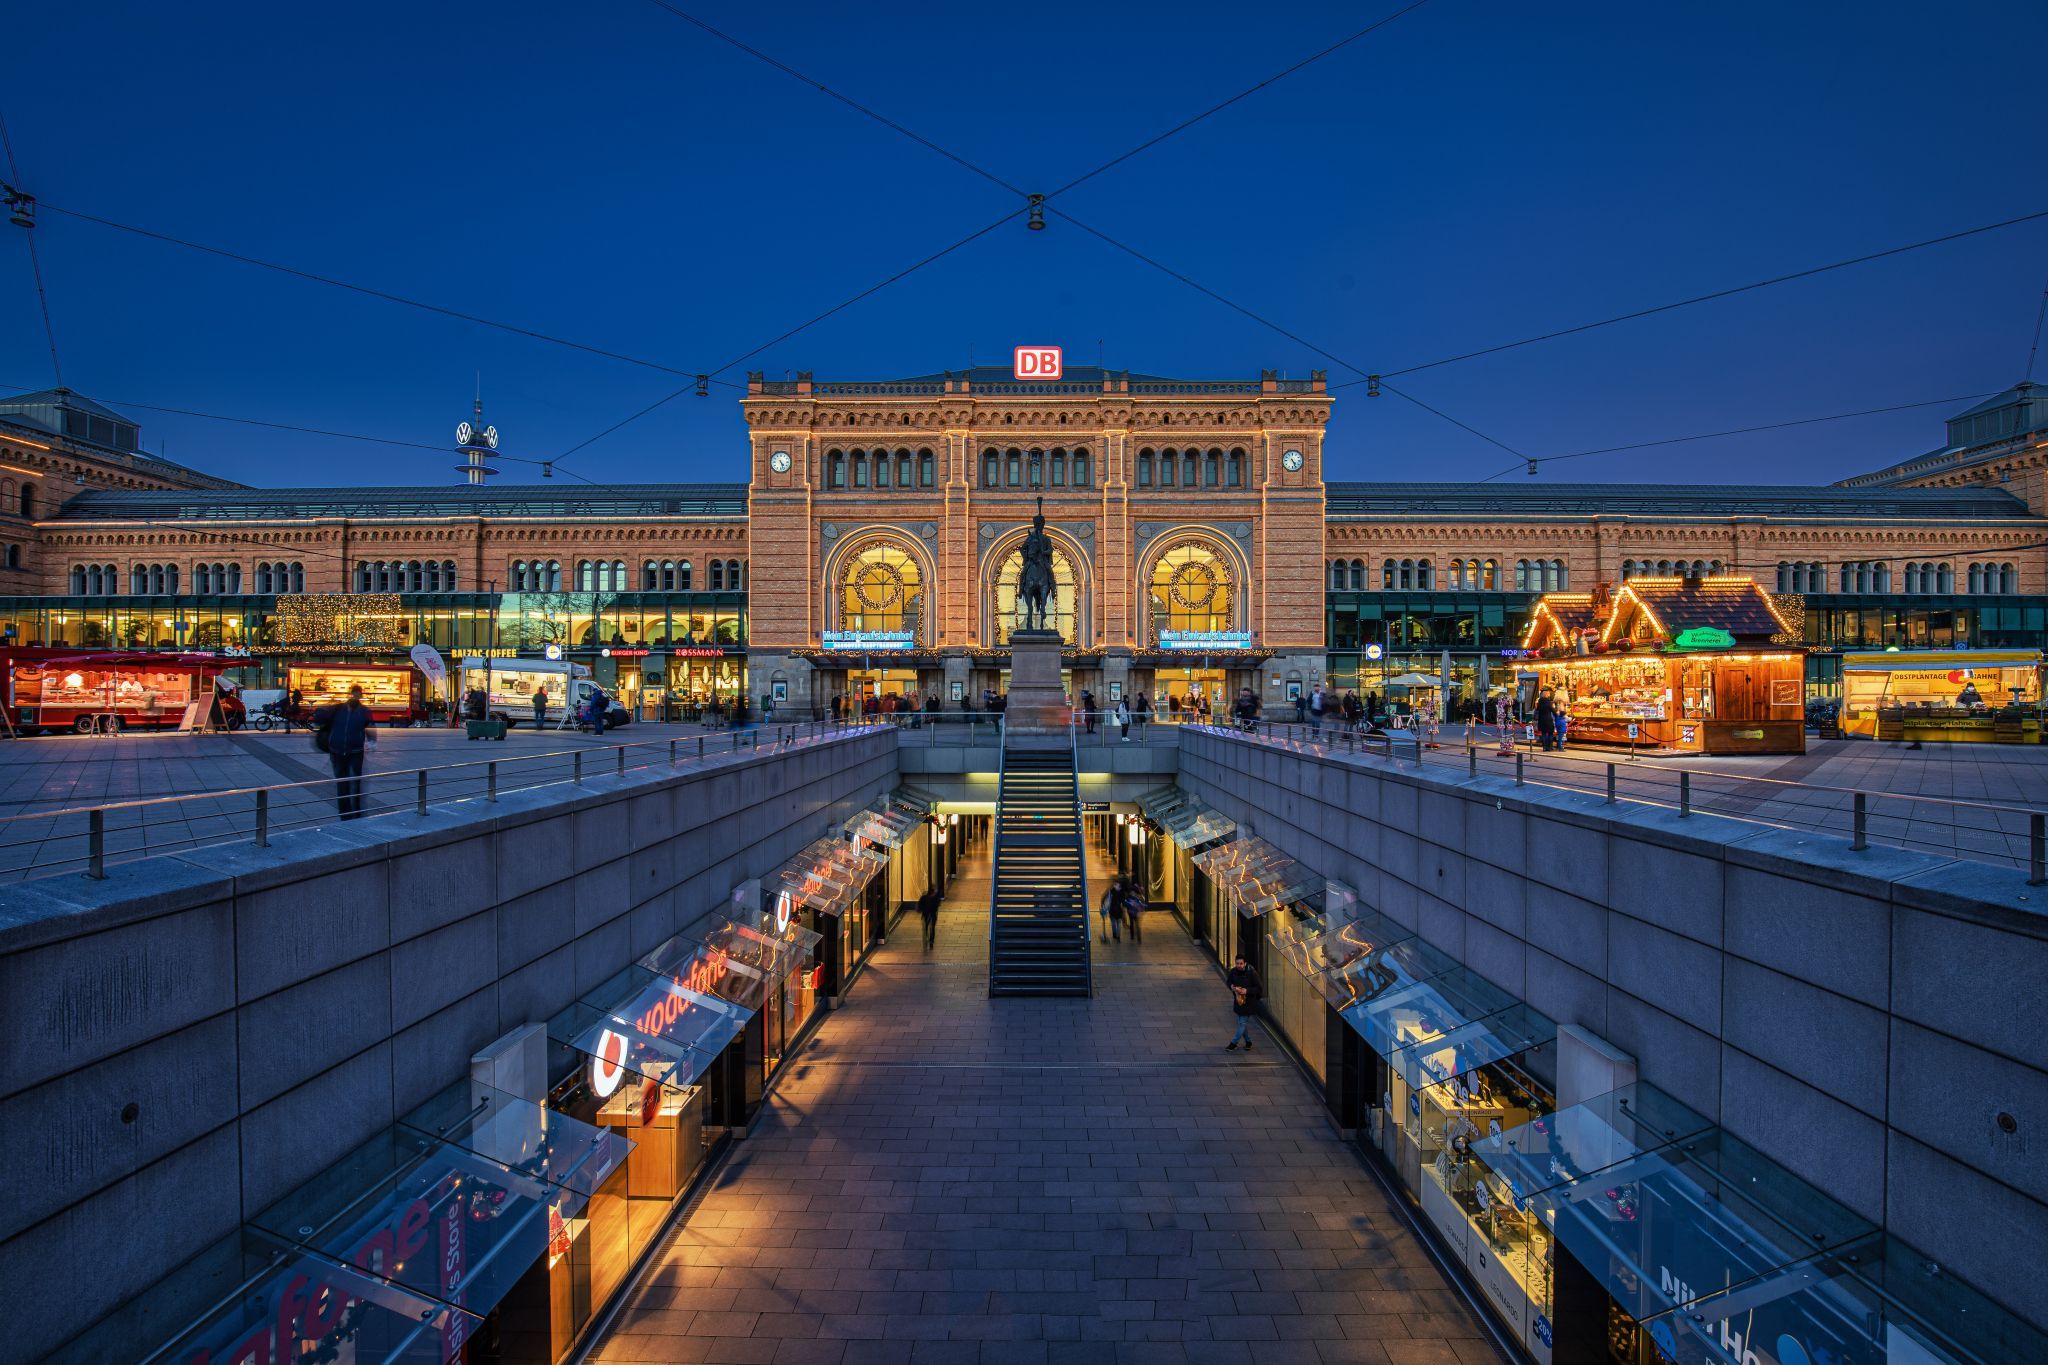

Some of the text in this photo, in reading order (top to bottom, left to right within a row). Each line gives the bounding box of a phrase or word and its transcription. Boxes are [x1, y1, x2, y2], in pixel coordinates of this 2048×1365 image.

[1020, 352, 1057, 374] DB
[456, 422, 472, 445] VW
[823, 630, 914, 640] Mein Einkaufsbahnhof
[1160, 630, 1252, 640] Mein Einkaufsbahnhof
[675, 648, 724, 657] ROSSMANN
[447, 1203, 460, 1272] Store
[1489, 1279, 1518, 1321] LEONARDO
